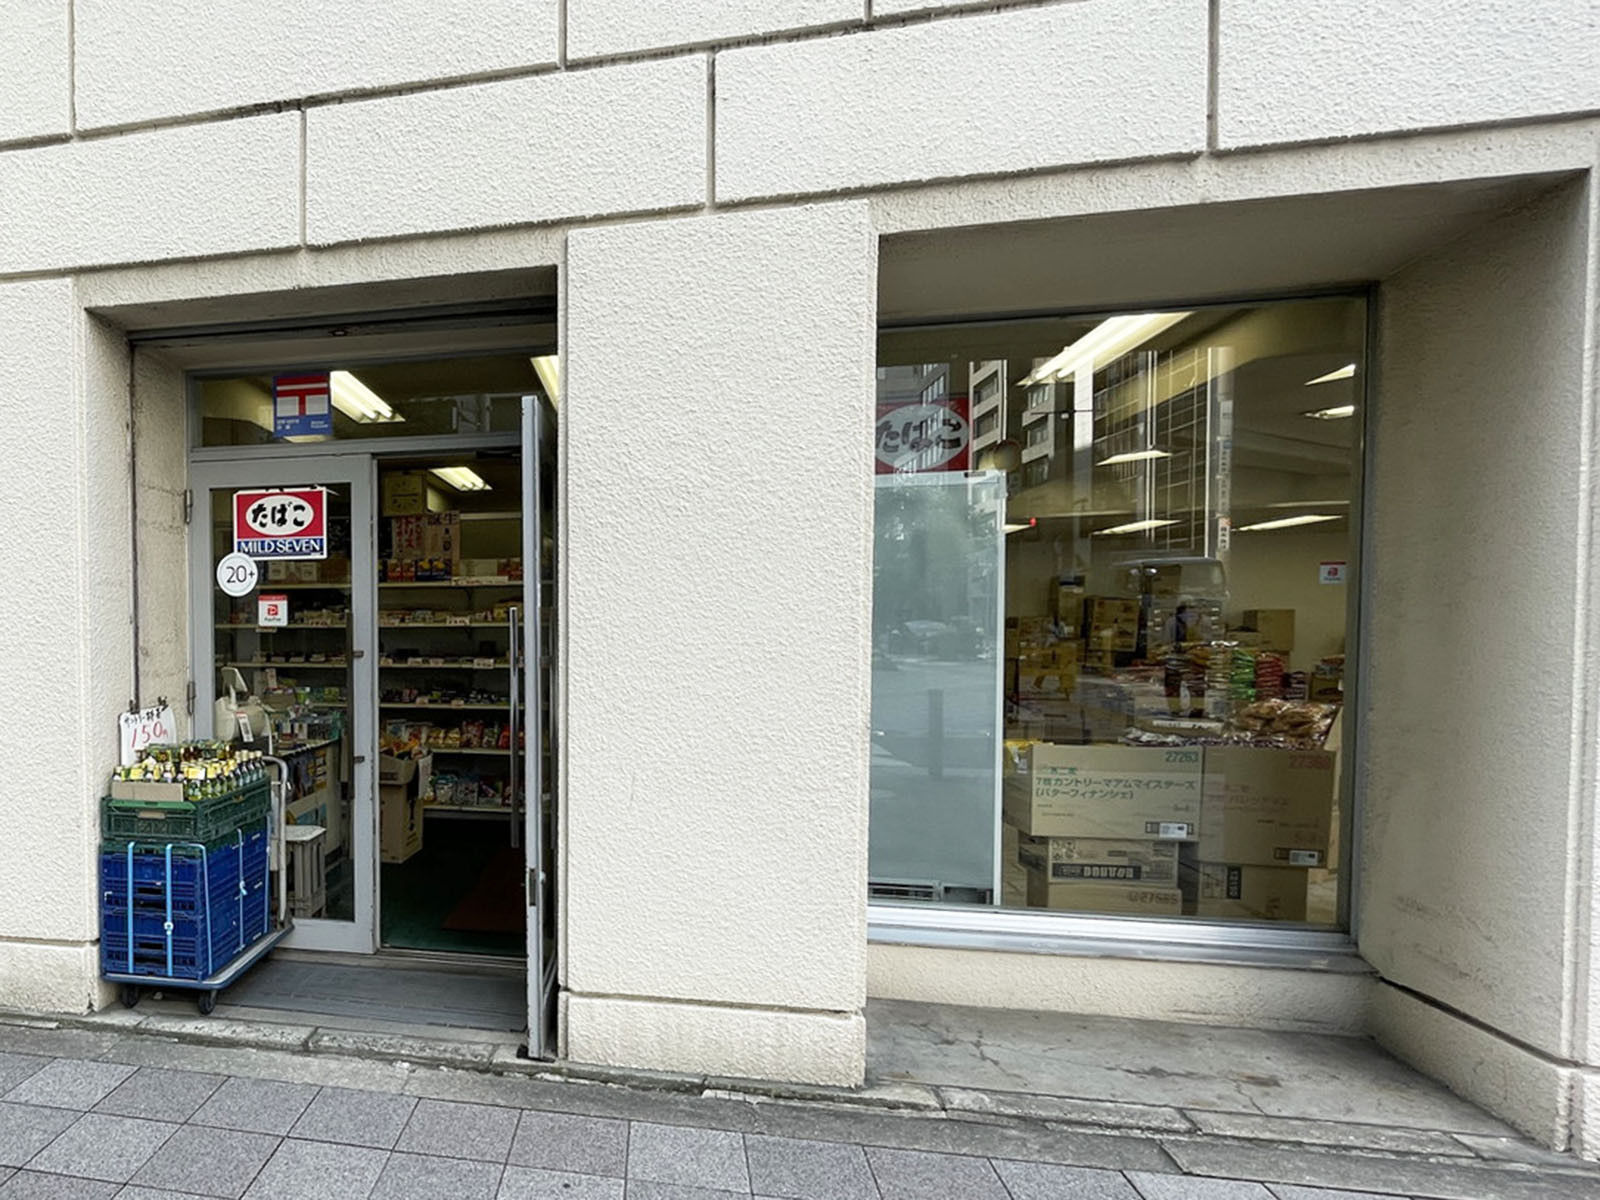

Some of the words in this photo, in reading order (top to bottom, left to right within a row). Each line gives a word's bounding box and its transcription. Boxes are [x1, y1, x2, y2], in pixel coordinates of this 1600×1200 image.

[251, 501, 306, 529] たばこ
[239, 541, 275, 554] MILD
[276, 539, 321, 553] SEVEN
[226, 564, 256, 584] 20+
